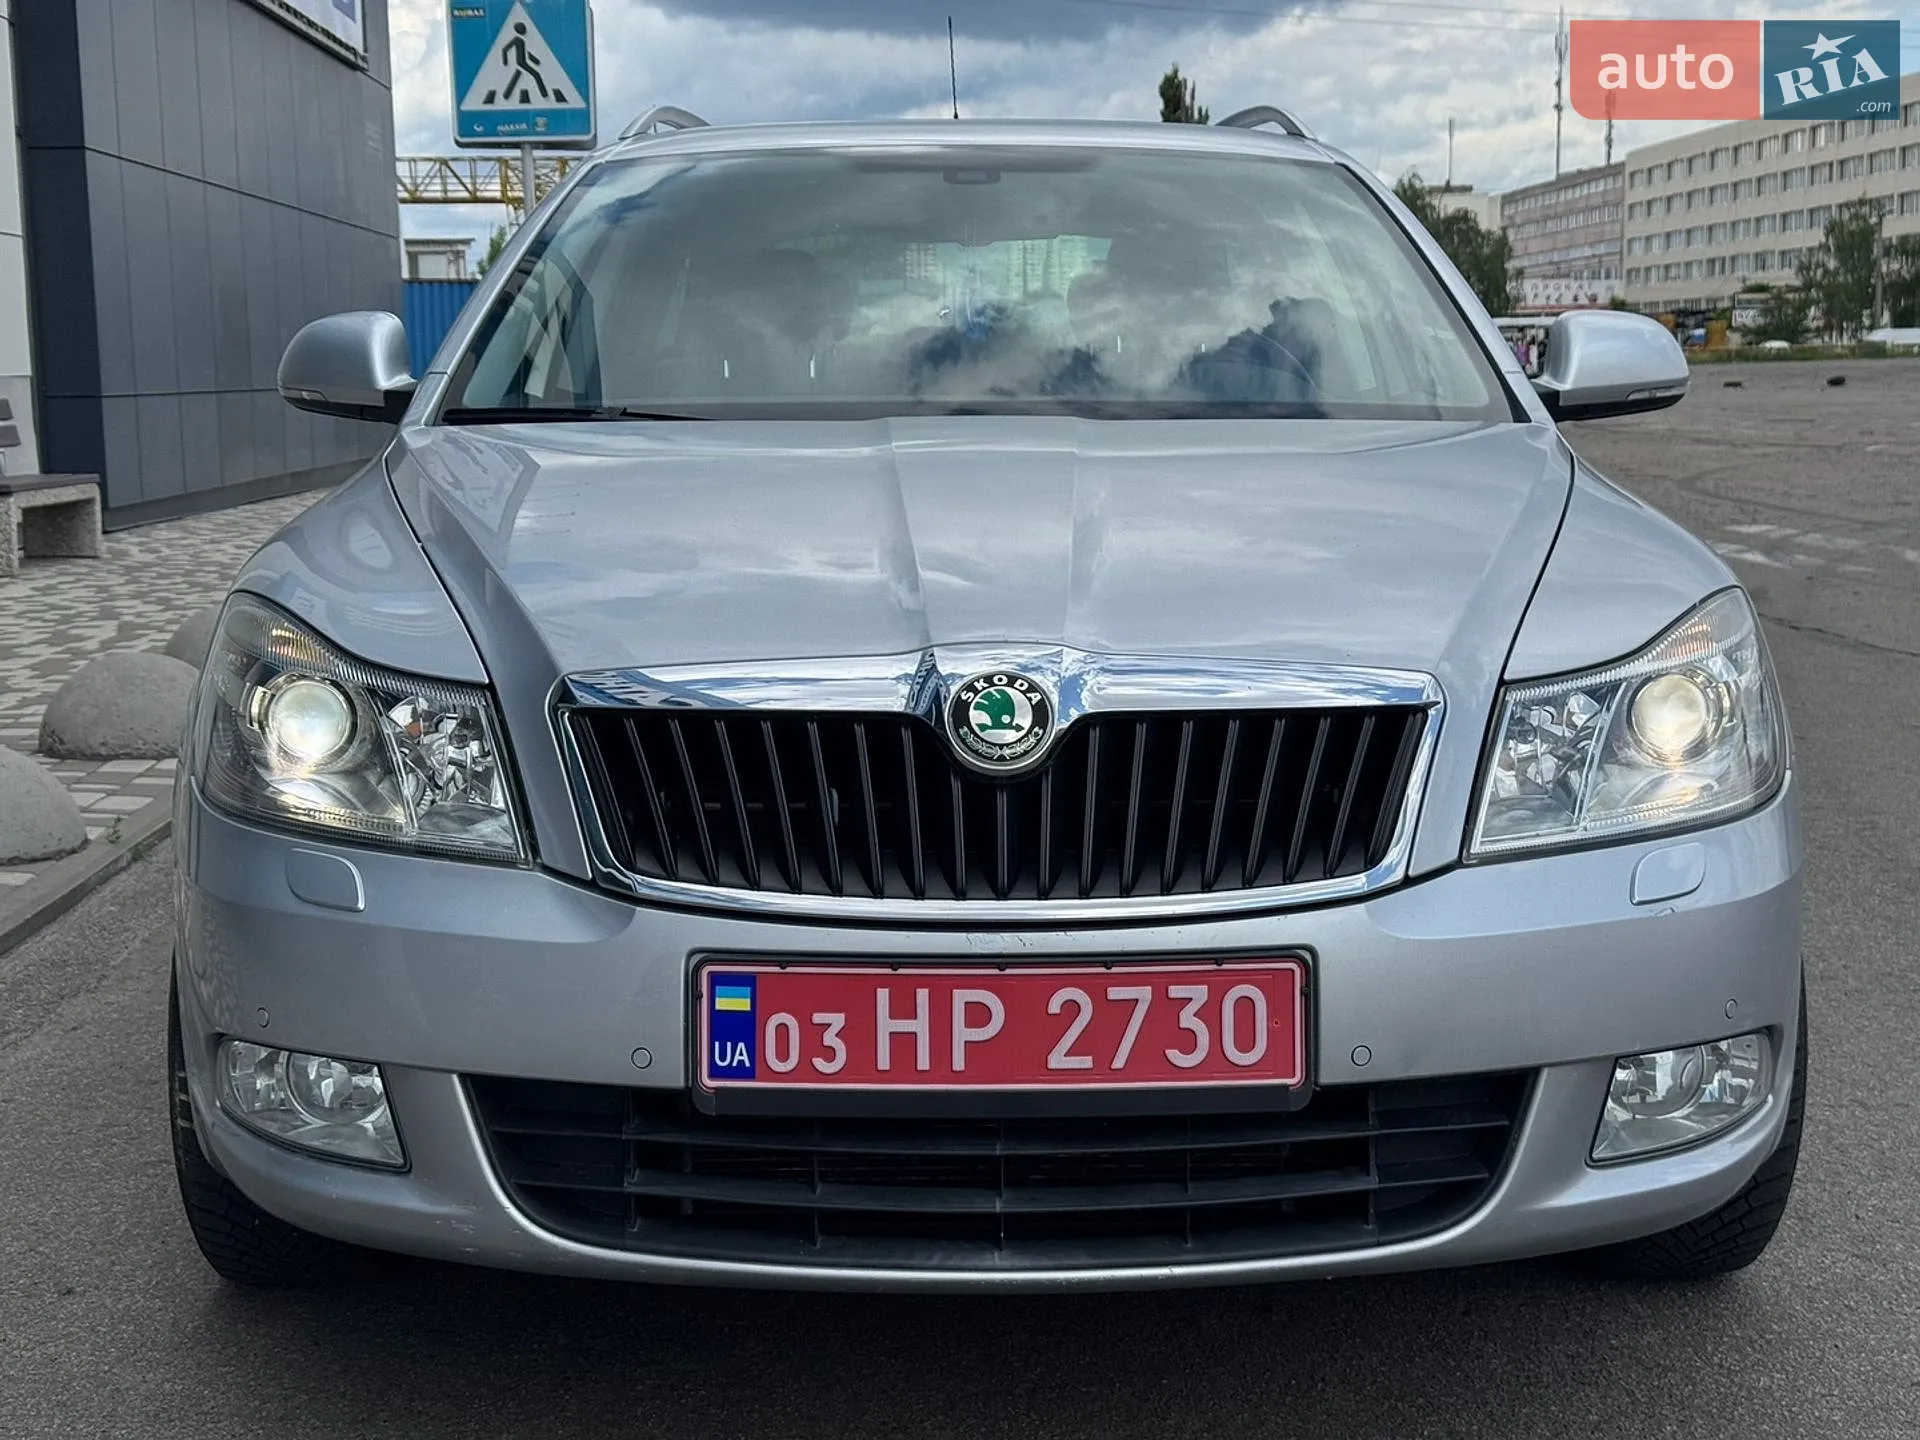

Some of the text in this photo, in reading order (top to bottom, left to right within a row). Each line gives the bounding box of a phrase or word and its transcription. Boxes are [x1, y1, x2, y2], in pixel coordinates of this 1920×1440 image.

[961, 674, 1042, 706] SKODA
[764, 984, 1268, 1074] 03 HP 2730
[714, 1041, 750, 1067] UA
